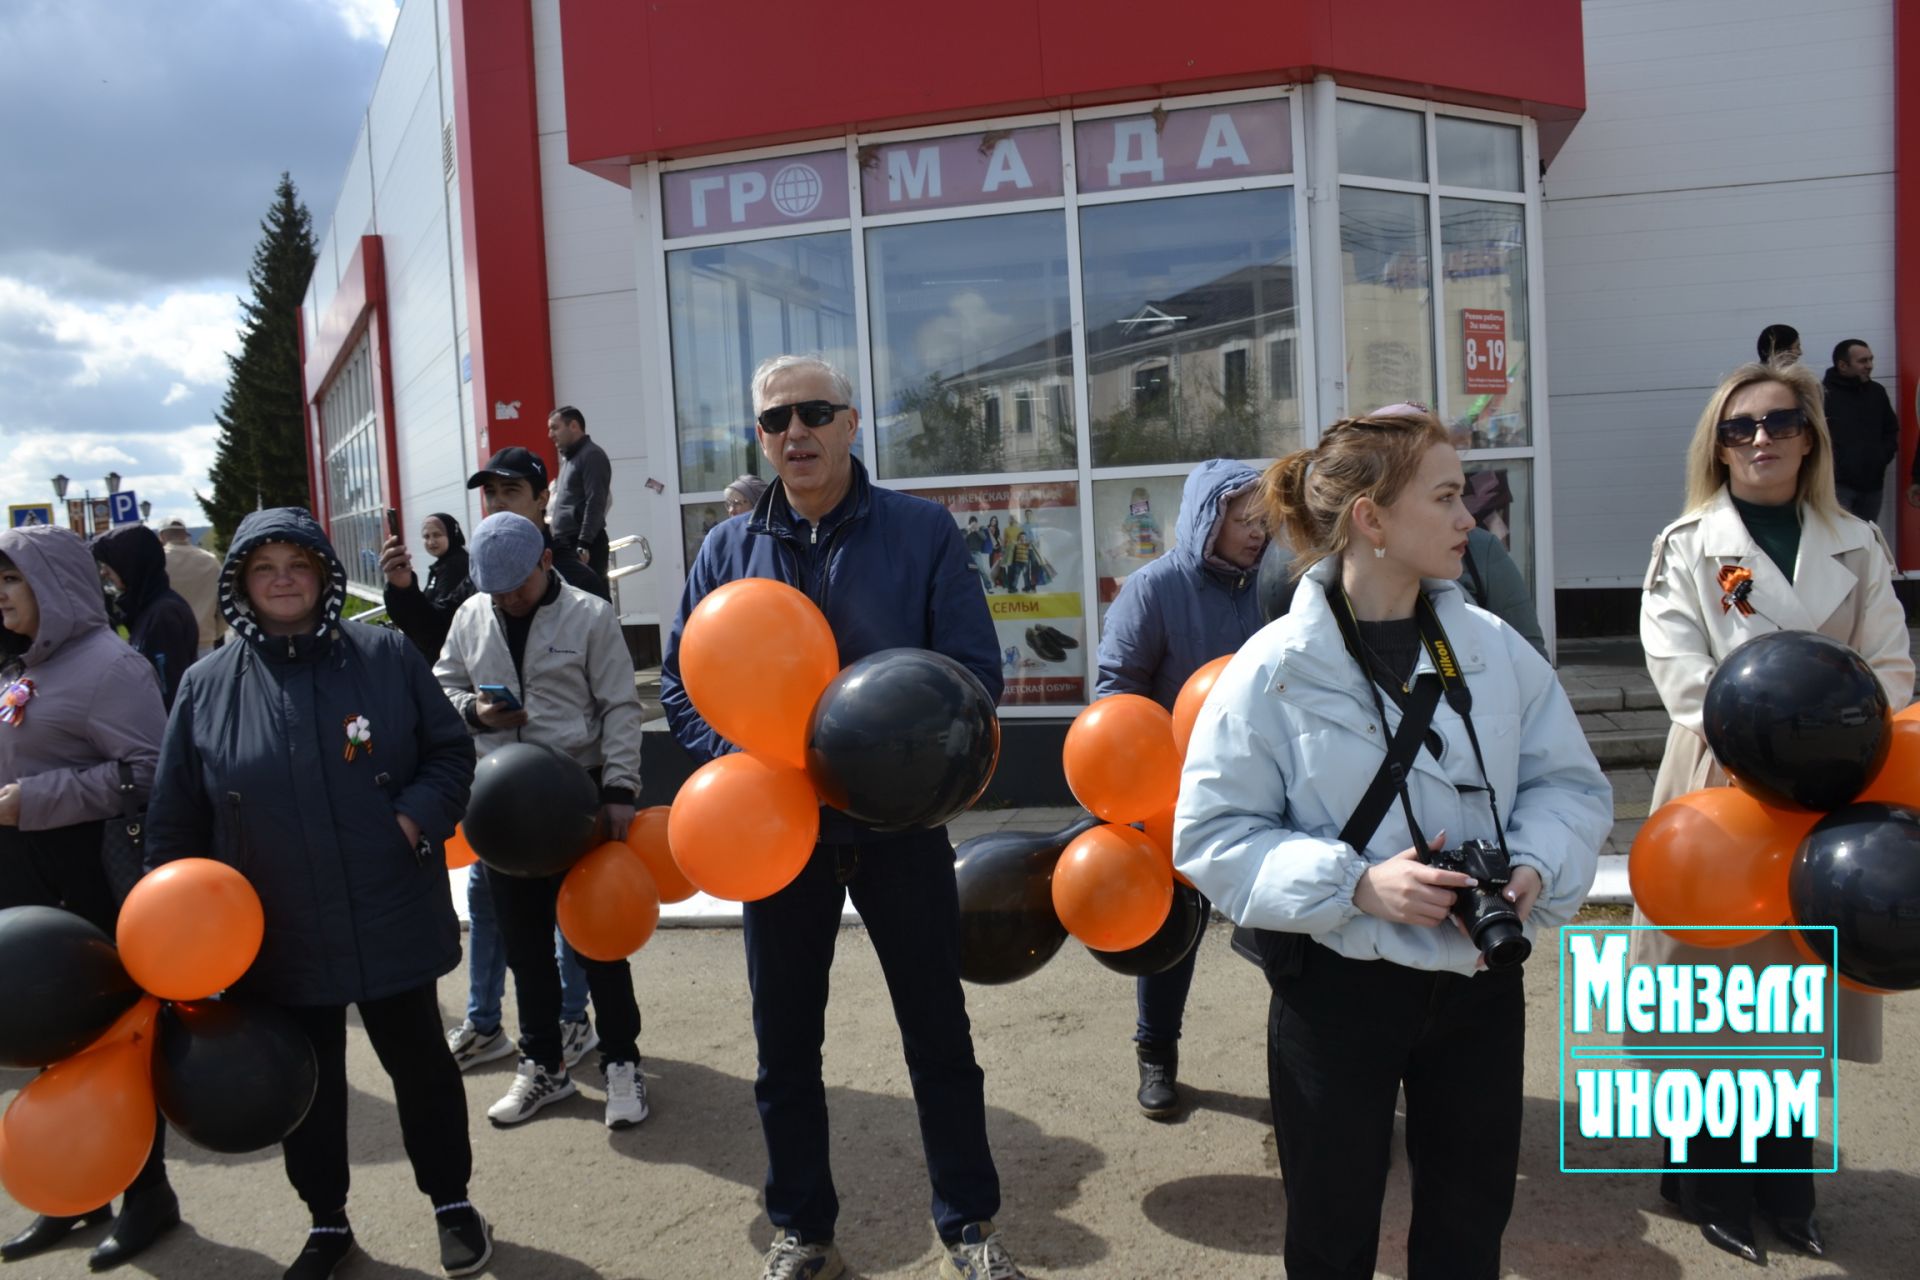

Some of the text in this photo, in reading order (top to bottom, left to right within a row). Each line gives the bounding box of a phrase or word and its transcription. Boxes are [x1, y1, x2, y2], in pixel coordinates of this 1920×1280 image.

[1467, 338, 1504, 370] 8-19
[115, 495, 132, 521] P
[992, 601, 1040, 613] СЕМЬИ
[1434, 640, 1457, 678] Nikon
